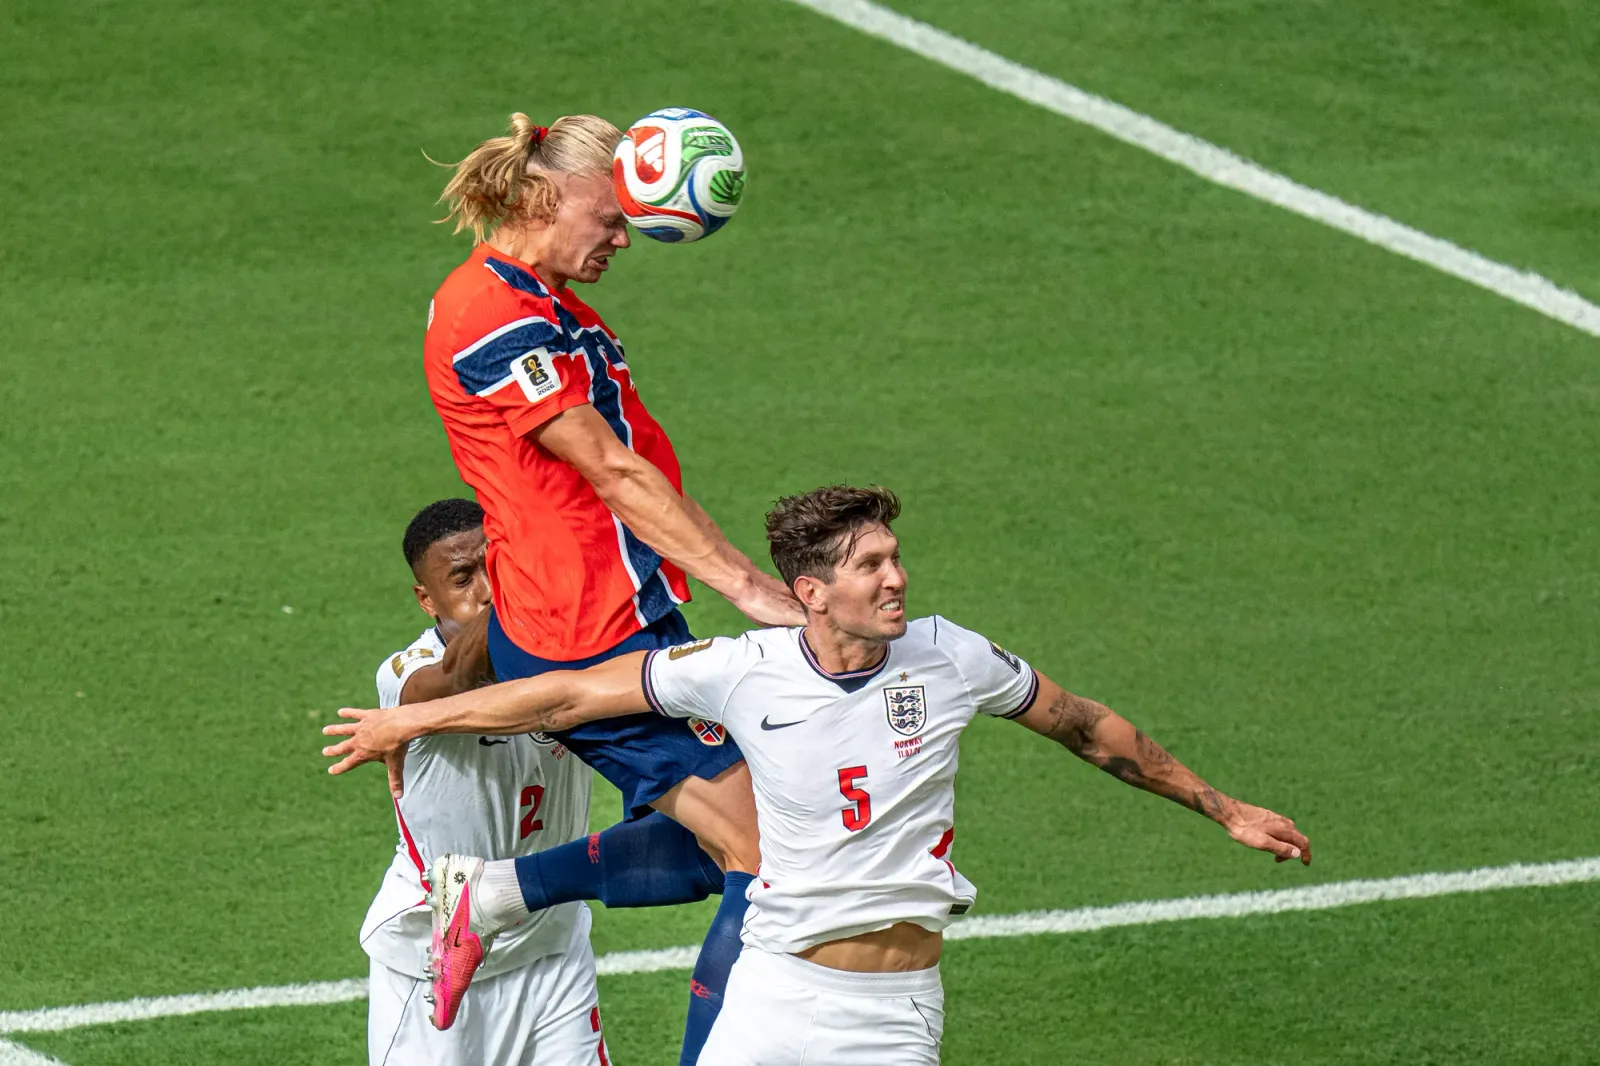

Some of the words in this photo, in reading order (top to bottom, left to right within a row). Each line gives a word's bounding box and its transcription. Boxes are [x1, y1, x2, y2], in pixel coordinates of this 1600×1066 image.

[537, 383, 555, 396] 2026
[894, 735, 923, 749] NORWAY
[520, 784, 545, 840] 2
[838, 765, 871, 832] 5
